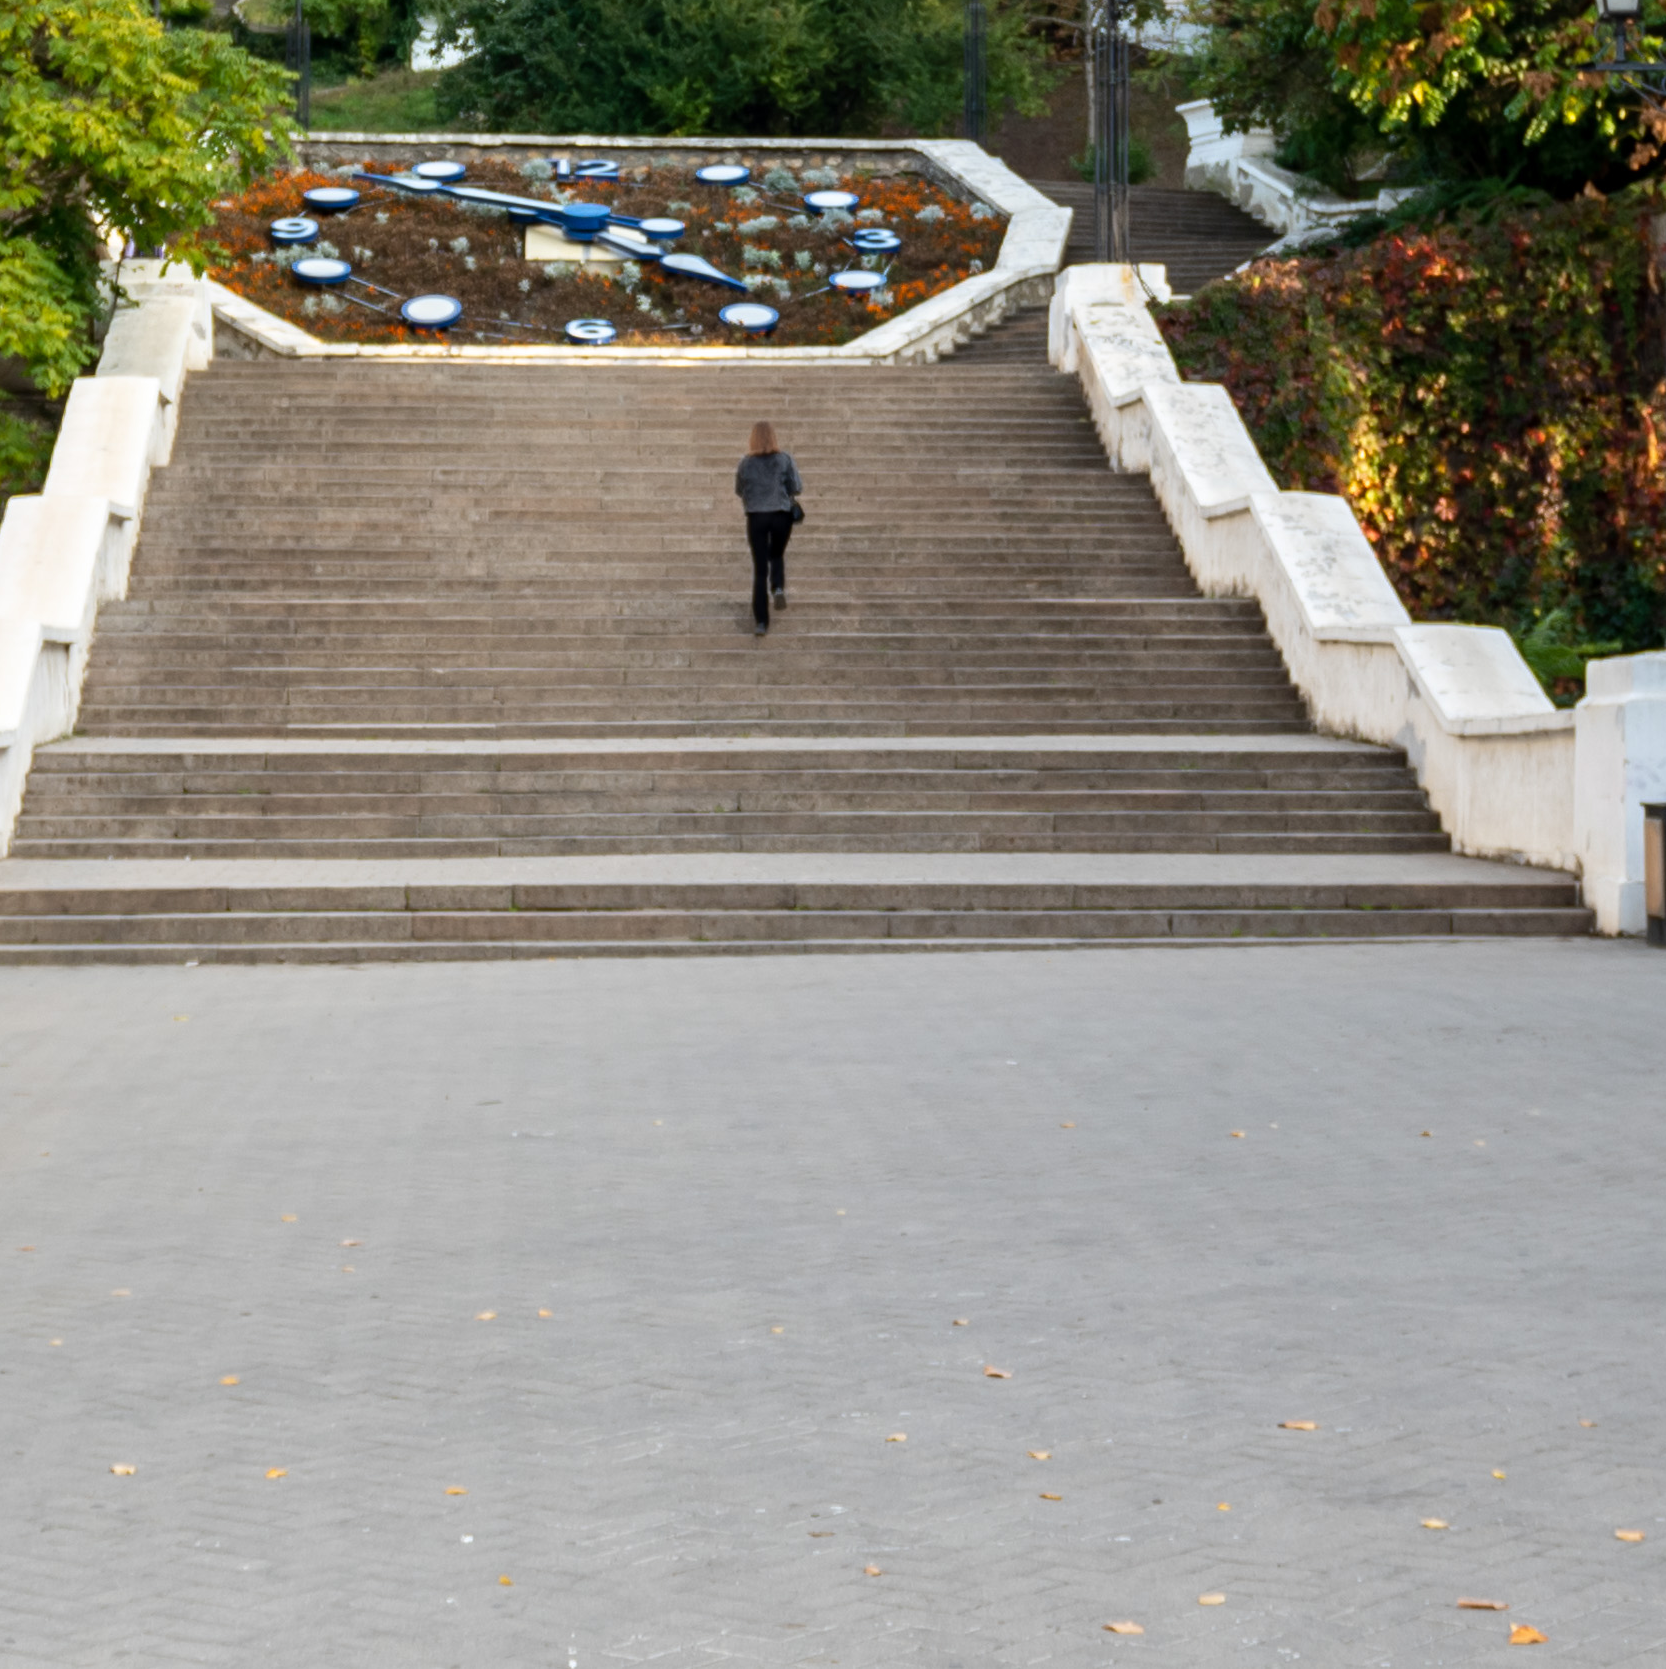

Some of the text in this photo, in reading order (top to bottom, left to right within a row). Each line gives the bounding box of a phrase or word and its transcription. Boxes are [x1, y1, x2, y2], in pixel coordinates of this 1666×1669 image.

[546, 158, 620, 180] 12
[271, 218, 319, 241] 9
[853, 228, 901, 250] 3
[565, 319, 616, 341] 6
